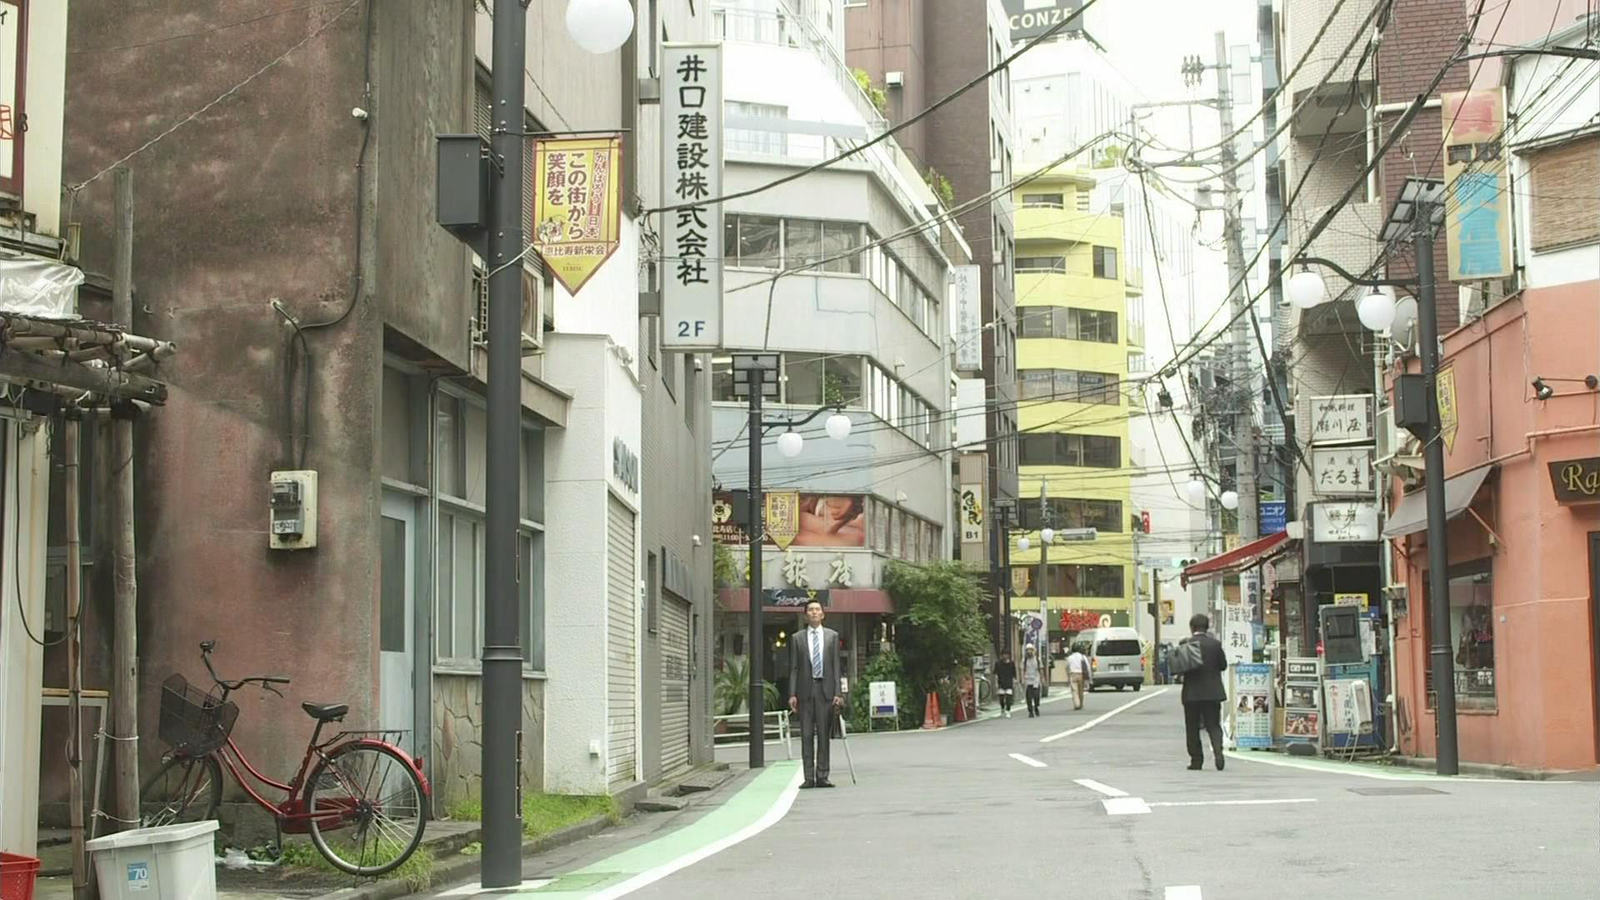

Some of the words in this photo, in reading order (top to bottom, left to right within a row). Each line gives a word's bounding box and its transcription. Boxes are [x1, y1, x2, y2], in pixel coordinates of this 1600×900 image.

[676, 54, 711, 286] 井口建設株式会社
[546, 153, 567, 206] 笑顔を
[567, 153, 587, 240] この街から
[678, 320, 707, 338] 2F
[1320, 468, 1362, 485] だるま
[966, 531, 978, 539] B1
[133, 867, 148, 880] 70
